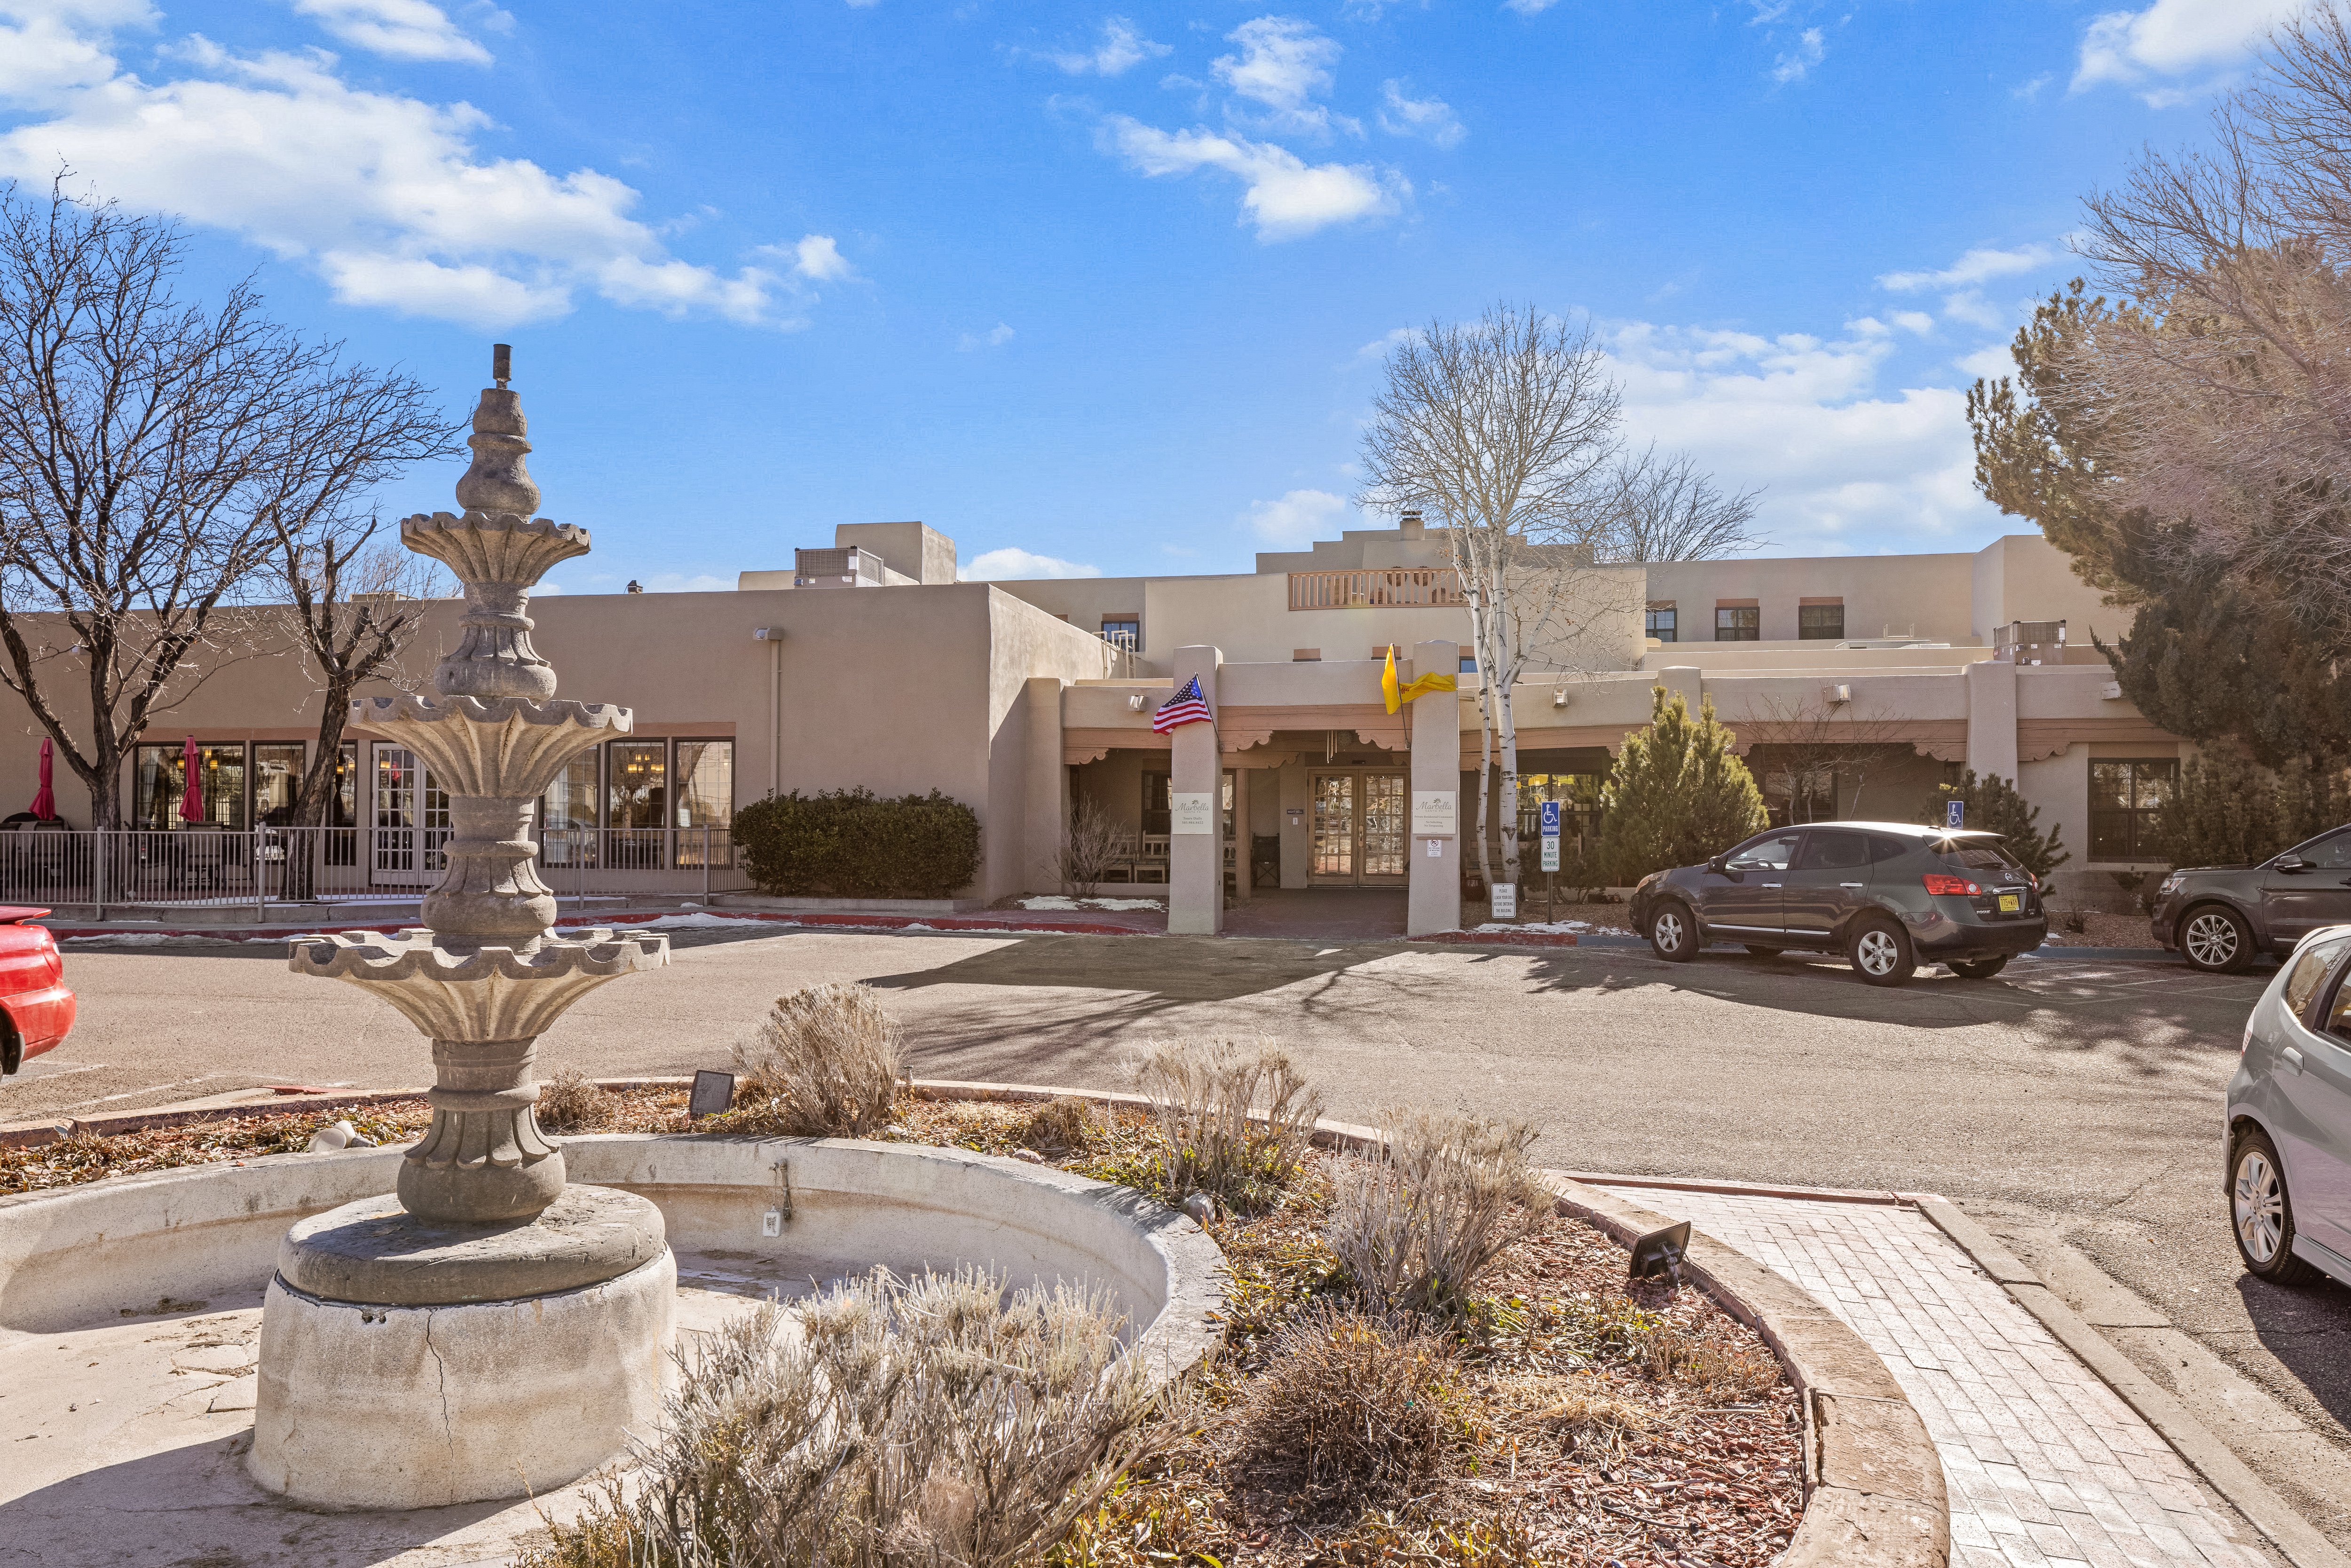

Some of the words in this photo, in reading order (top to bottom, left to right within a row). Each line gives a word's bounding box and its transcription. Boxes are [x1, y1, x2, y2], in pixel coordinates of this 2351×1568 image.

[1175, 803, 1209, 811] Marbella
[1416, 801, 1452, 810] Marbella
[1546, 841, 1554, 850] 30
